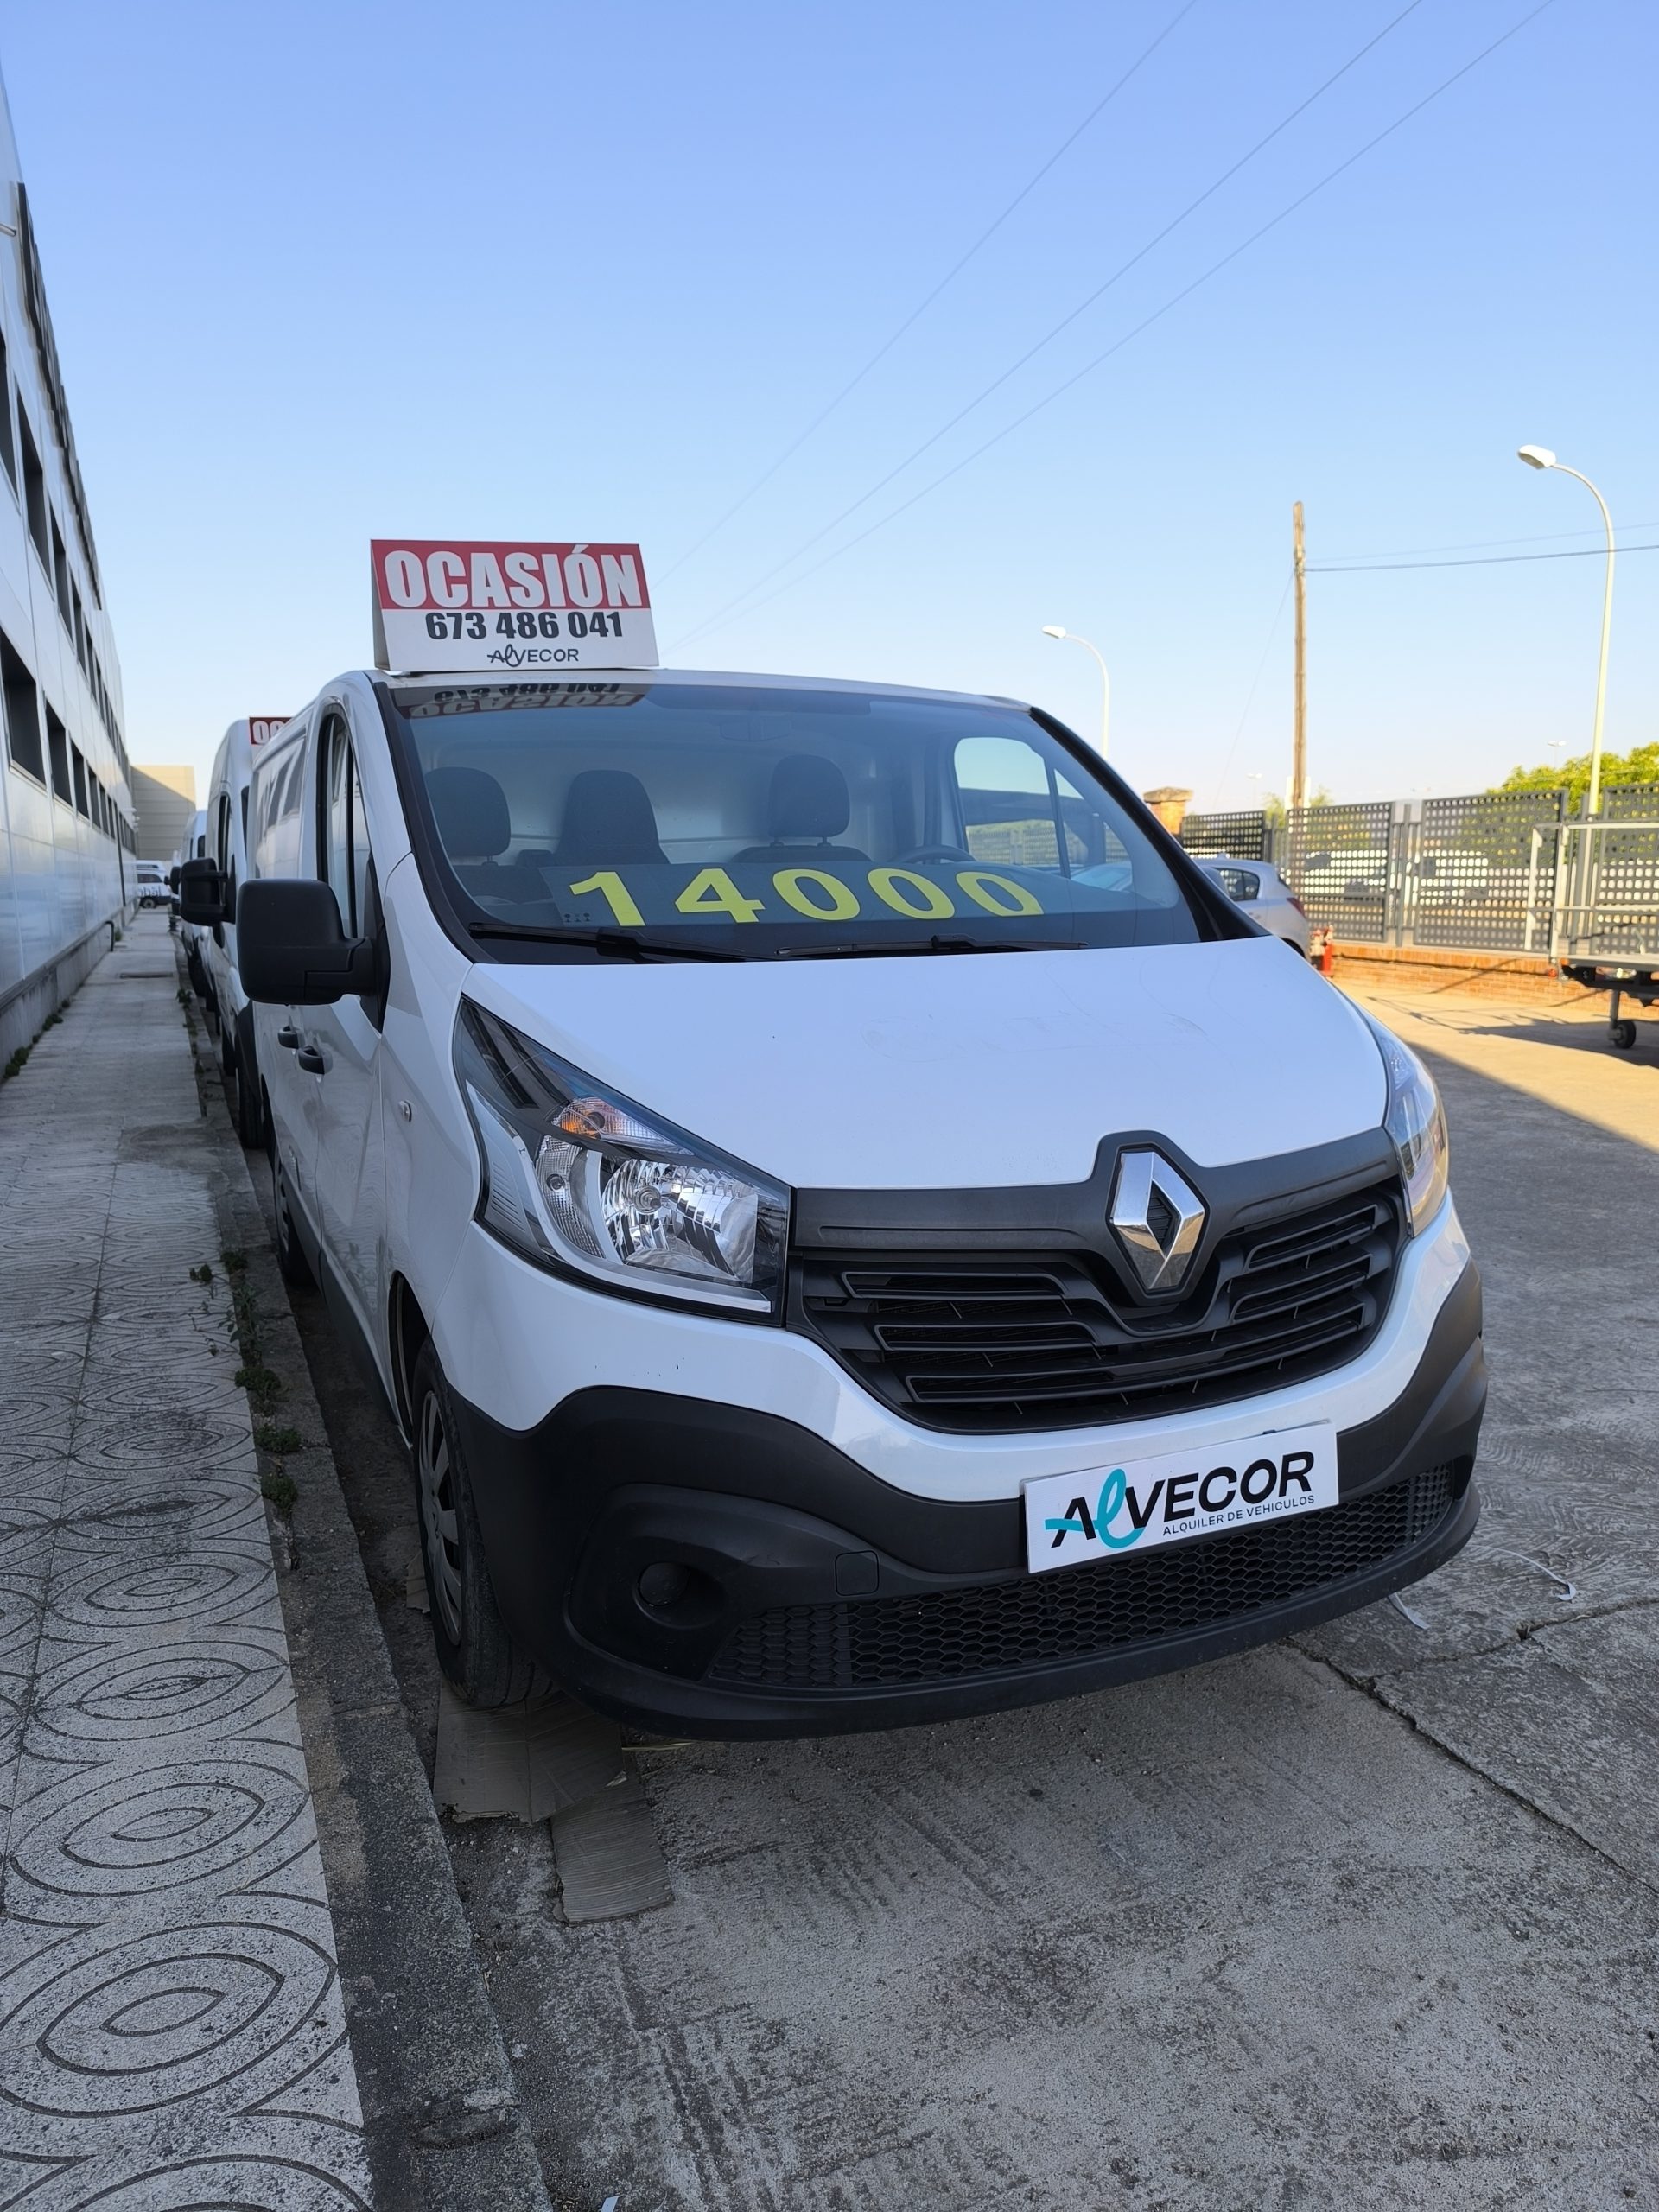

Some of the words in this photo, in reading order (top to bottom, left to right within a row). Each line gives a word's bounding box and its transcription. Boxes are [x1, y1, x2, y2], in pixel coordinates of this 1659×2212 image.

[384, 544, 643, 607] OCASIÓN
[425, 612, 487, 639] 673
[496, 612, 559, 639] 486
[567, 611, 623, 639] 041
[1162, 1514, 1224, 1536] ALQUILER
[1227, 1510, 1243, 1522] DE
[1246, 1495, 1315, 1517] VEHICULOS
